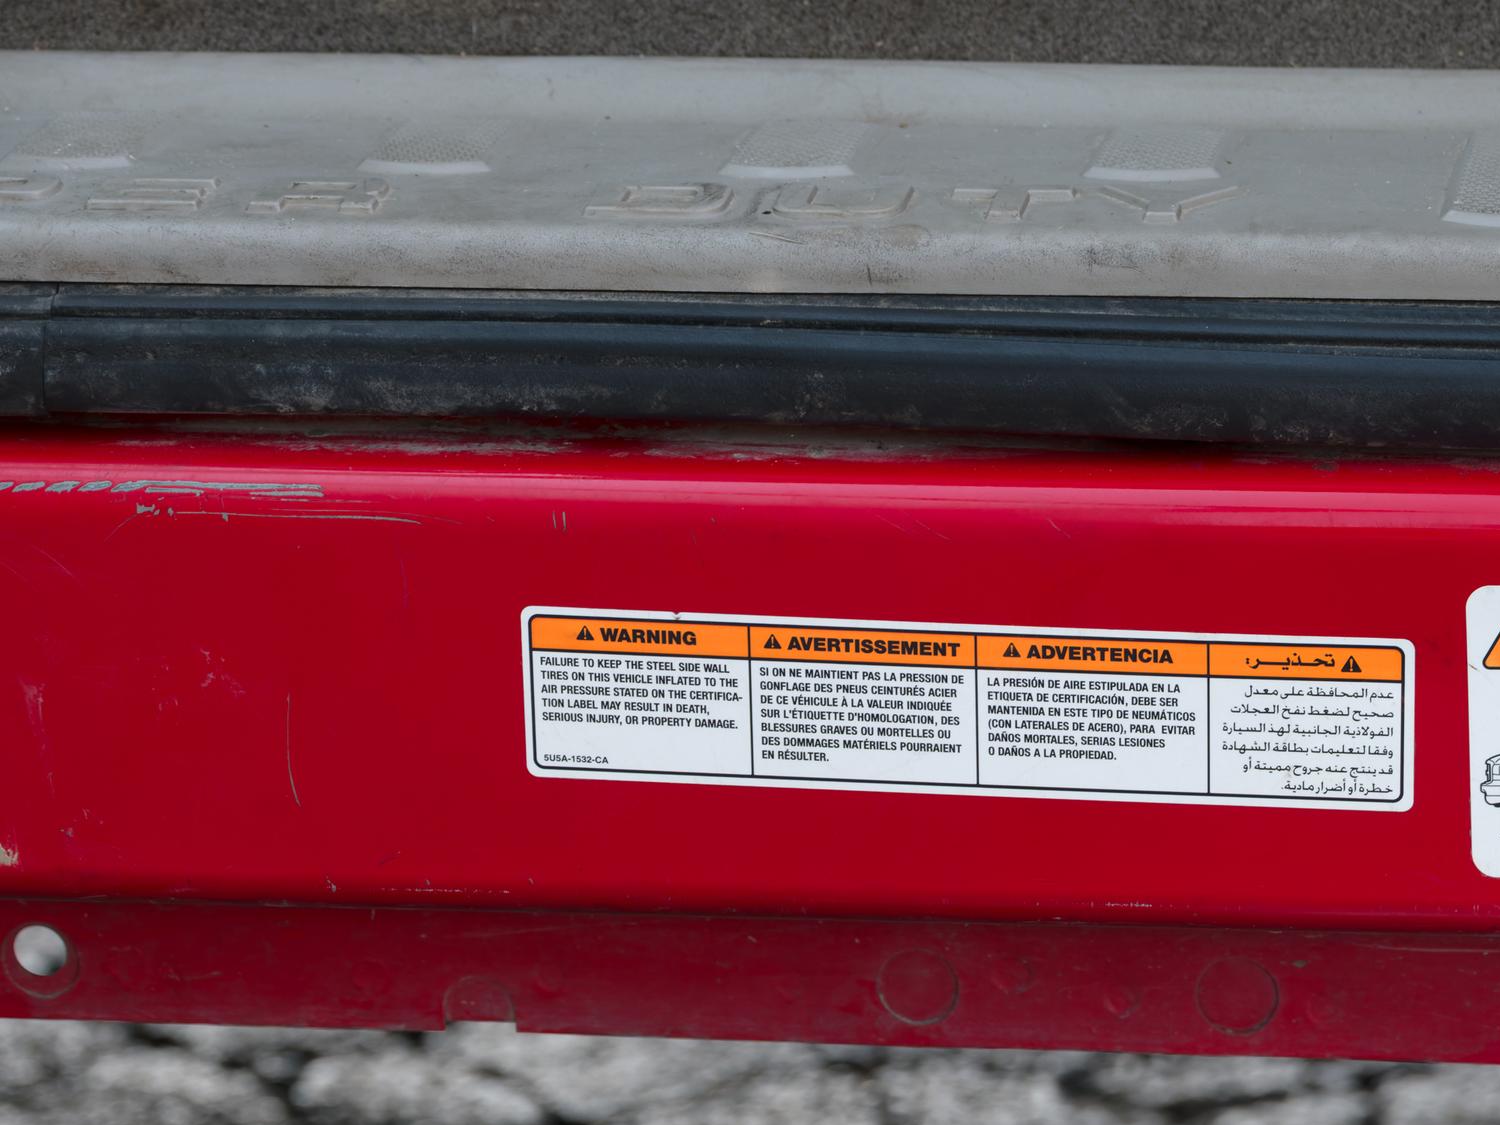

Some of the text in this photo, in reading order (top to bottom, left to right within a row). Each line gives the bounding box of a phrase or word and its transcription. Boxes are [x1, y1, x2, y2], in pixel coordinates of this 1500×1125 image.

[578, 178, 1245, 224] DUTY
[599, 627, 697, 646] WARNING
[787, 636, 961, 657] AVERTISSEMENT
[1026, 644, 1173, 664] ADVERTENCIA
[540, 656, 730, 674] FAILURE TO KEEP THE STEEL SIDE WALL
[540, 670, 738, 688] TIRES ON THIS VEHICLE INFLATED TO THE
[759, 666, 964, 684] SI ON NE MAINTIENT PAS LA PRESSION DE
[541, 684, 743, 702] AIR PRESSURE STATED ON THE CERTIFICA-
[760, 680, 957, 698] GONFLAGE DES PNEUS CEINTURÉS ACIER
[987, 676, 1181, 693] LA PRESIÓN DE AIRE ESTIPULADA EN LA
[541, 698, 710, 716] TION LABEL MAY RESULT IN DEATH,
[760, 694, 952, 712] DE CE VÉHICULE À LA VALEUR INDIQUÉE
[987, 691, 1178, 707] ETIQUETA DE CERTIFICACIÓN, DEBE SER
[542, 711, 738, 729] SERIOUS INJURY, OR PROPERTY DAMAGE.
[760, 707, 960, 726] SUR L'ÉTIQUETTE D'HOMOLOGATION, DES
[987, 704, 1196, 722] MANTENIDA EN ESTE TIPO DE NEUMÁTICOS
[761, 722, 951, 739] BLESSURES GRAVES OU MORTELLES OU
[988, 718, 1195, 735] (CON LATERALES DE ACERO), PARA EVITAR
[761, 736, 962, 753] DES DOMMAGES MATÉRIELS POURRAIENT
[988, 731, 1166, 748] DAÑOS MORTALES, SERIAS LESIONES
[761, 748, 829, 762] EN RÉSULTER.
[988, 745, 1117, 760] O DAÑOS A LA PROPIEDAD.
